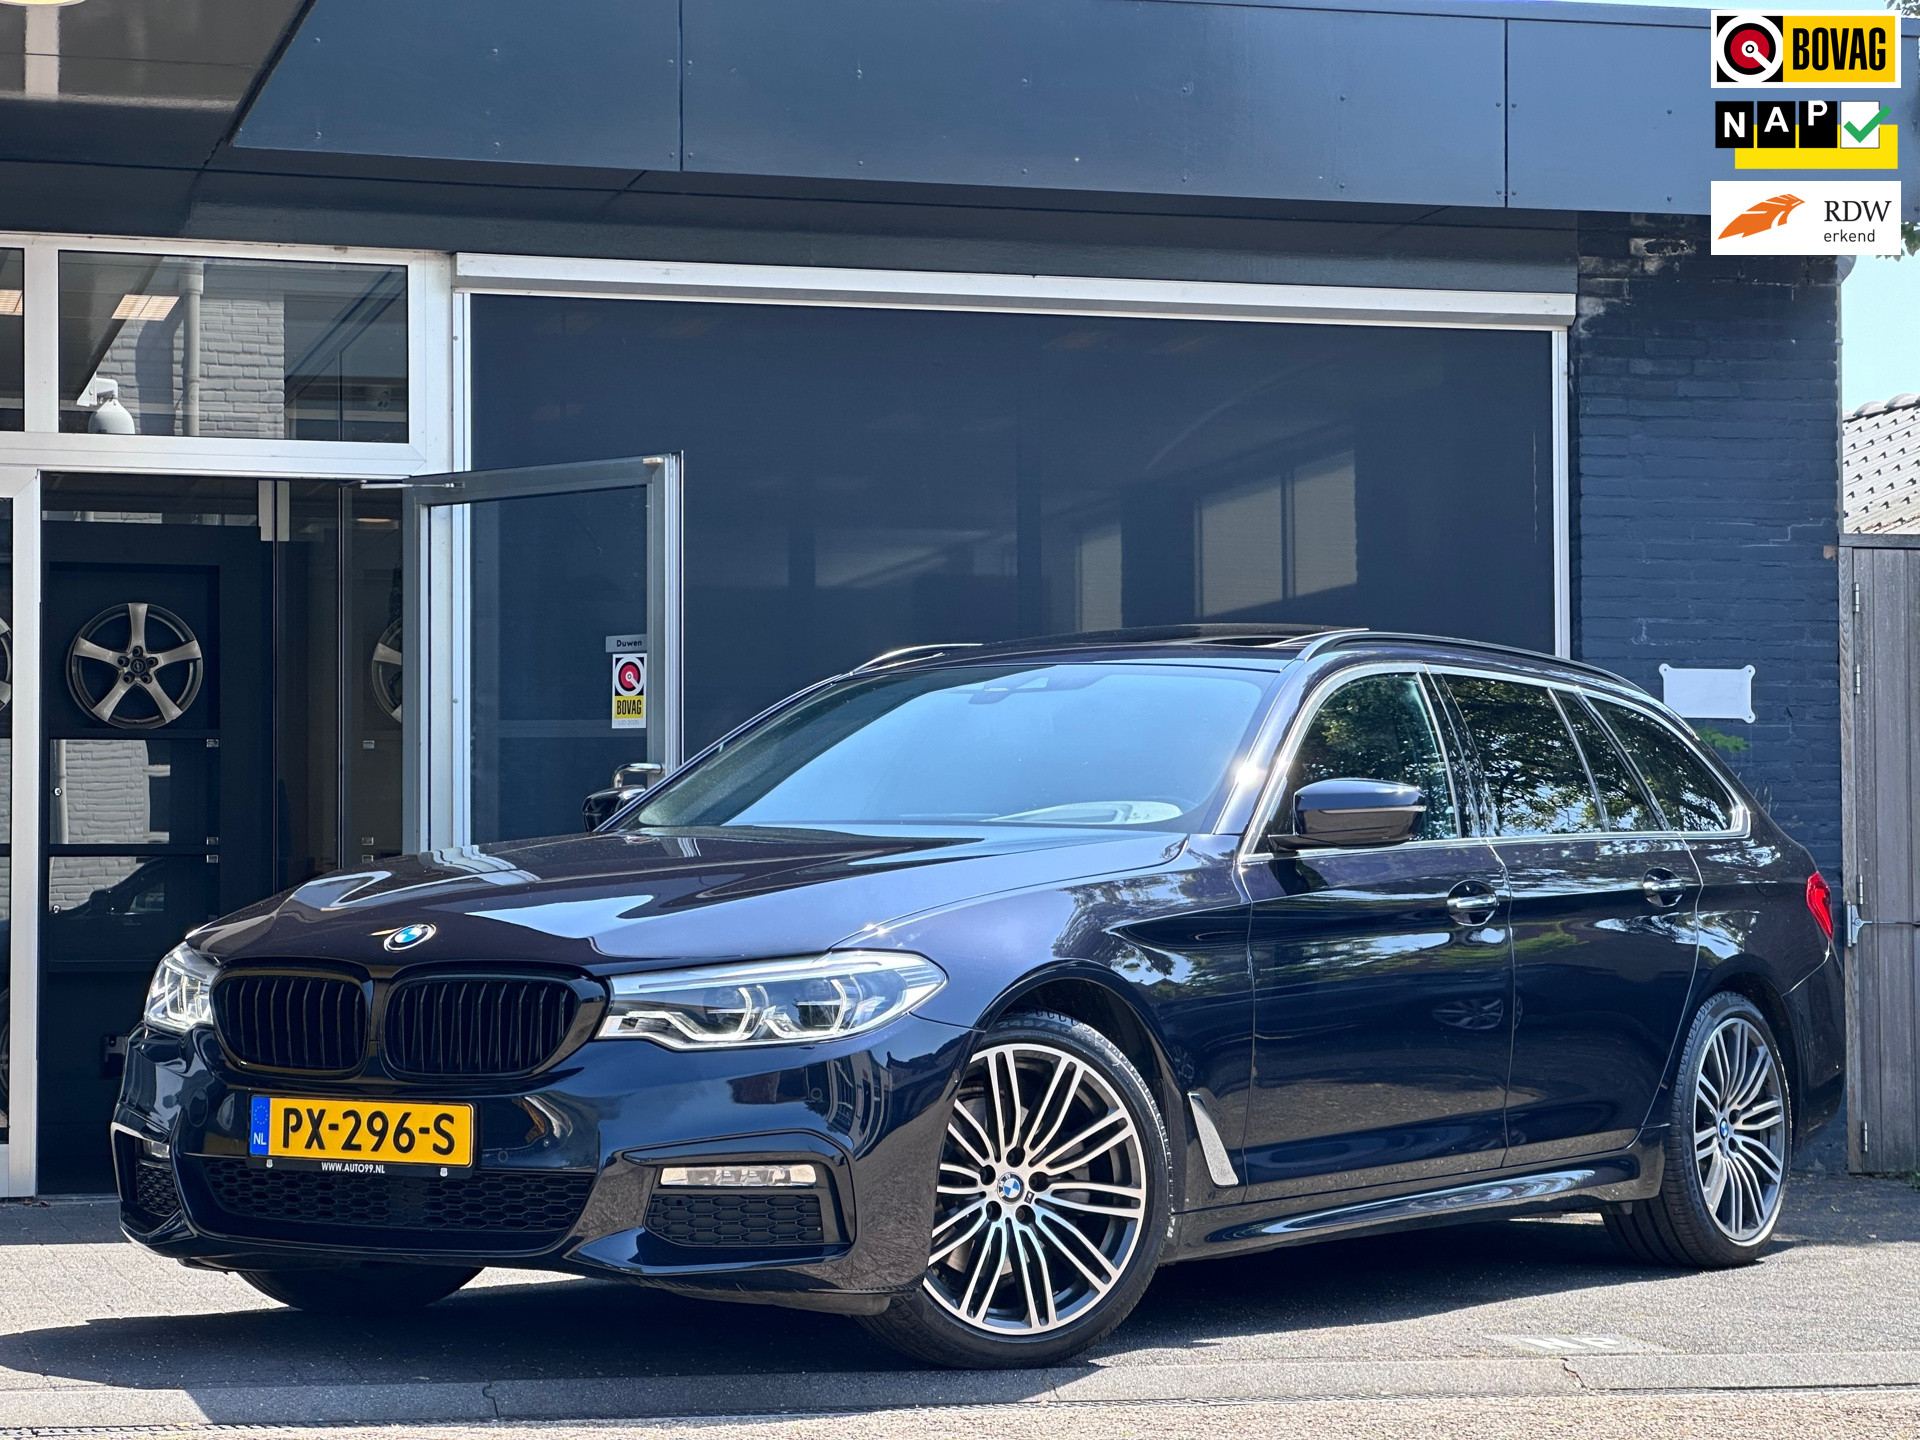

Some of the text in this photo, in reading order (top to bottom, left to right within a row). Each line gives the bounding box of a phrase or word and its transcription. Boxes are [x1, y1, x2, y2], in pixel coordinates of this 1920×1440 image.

[616, 639, 643, 647] Duwen
[616, 699, 642, 715] BOVAG
[282, 1107, 456, 1156] PX-296-S
[253, 1132, 267, 1146] NL
[321, 1161, 386, 1174] WWW.AUTO99.NL
